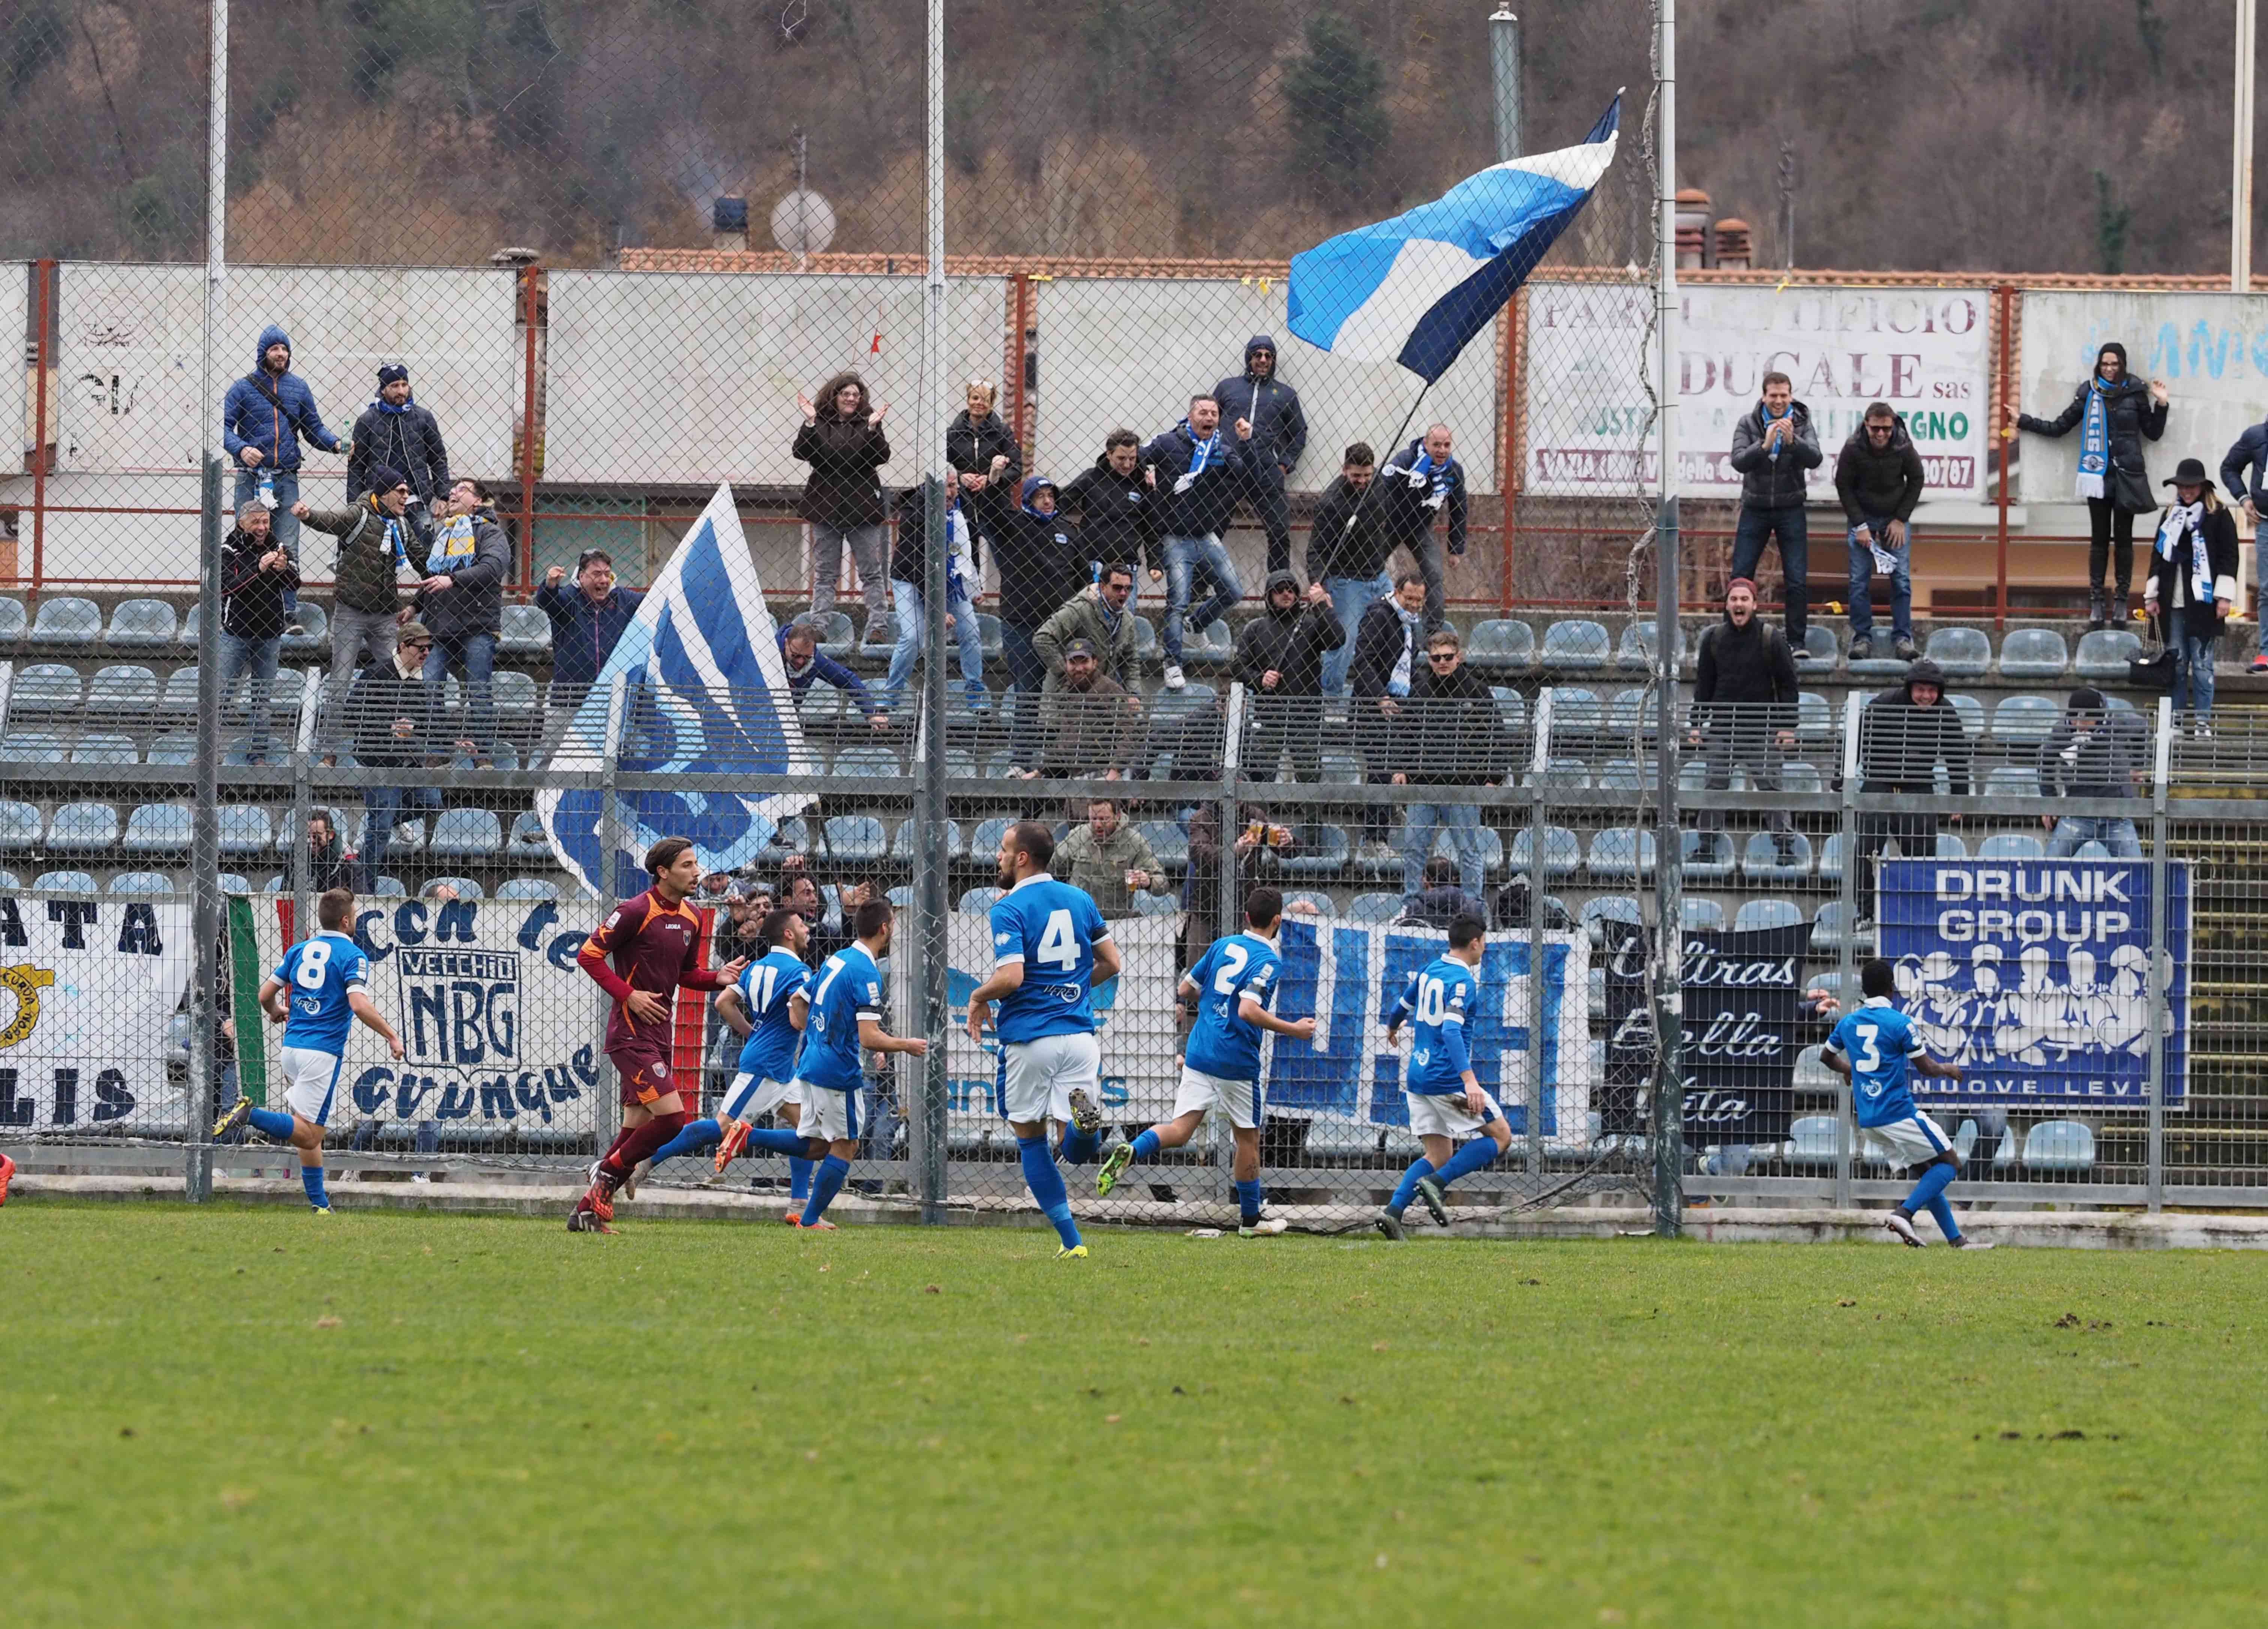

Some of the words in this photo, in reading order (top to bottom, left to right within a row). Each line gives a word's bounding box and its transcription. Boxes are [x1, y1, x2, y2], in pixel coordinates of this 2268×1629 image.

[1678, 351, 1922, 399] DUCALE
[1933, 381, 1971, 399] sas
[1936, 870, 2131, 902] DRUNK
[1037, 909, 1081, 971] 4
[1938, 910, 2130, 942] GROUP
[296, 940, 331, 989] 8
[814, 955, 846, 1005] 7
[1214, 942, 1248, 996] 2
[748, 965, 778, 1013] 11
[1416, 972, 1444, 1026] 10
[410, 981, 515, 1064] NBG
[1856, 1024, 1880, 1072] 3
[1913, 1080, 2038, 1094] NUOVE
